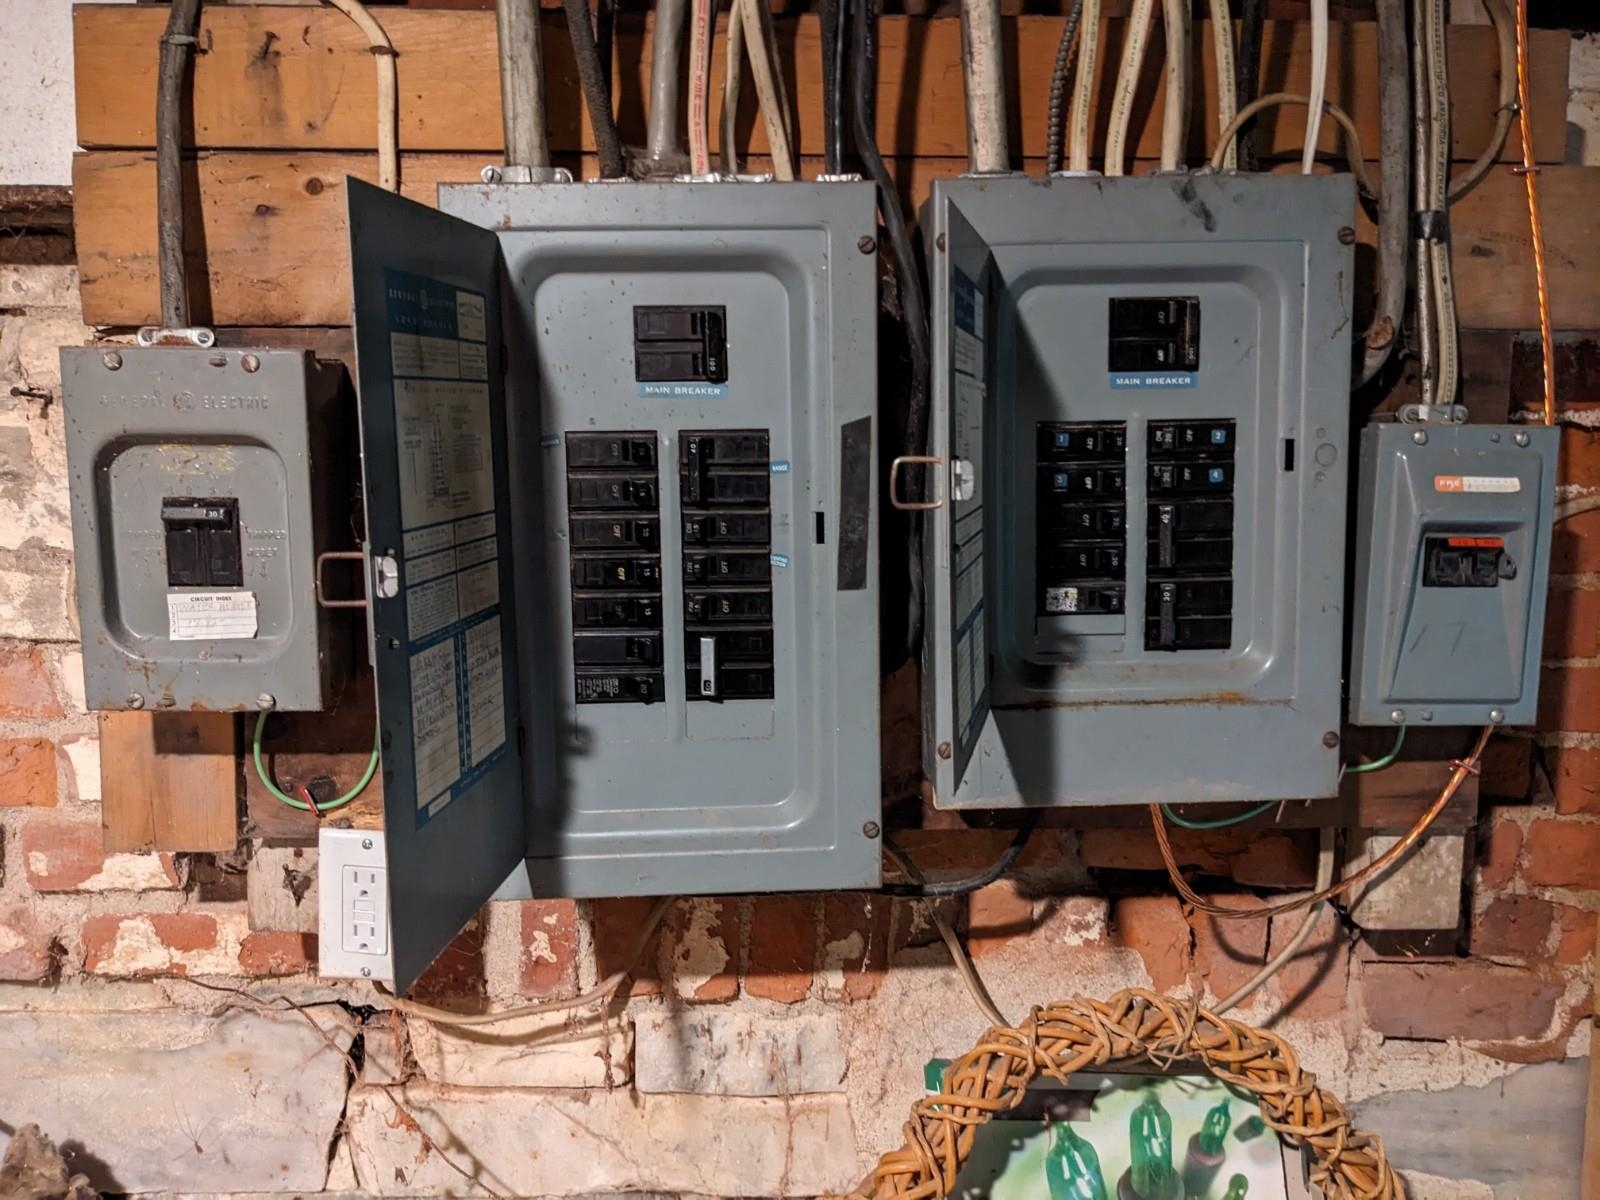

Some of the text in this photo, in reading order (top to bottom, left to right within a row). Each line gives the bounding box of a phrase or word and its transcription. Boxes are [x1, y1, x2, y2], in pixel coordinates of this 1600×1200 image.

[1115, 377, 1192, 386] MAIN BREAKER
[645, 385, 721, 396] MAIN BREAKER
[202, 393, 269, 409] ELECTRIC
[207, 510, 218, 518] 30
[1081, 512, 1090, 527] OFF
[612, 524, 621, 539] OFF
[720, 520, 729, 535] OFF
[1079, 553, 1088, 567] OFF
[720, 560, 730, 575] OFF
[616, 567, 626, 583] OFF
[190, 595, 214, 603] CIRCUIT
[723, 600, 732, 614] OFF
